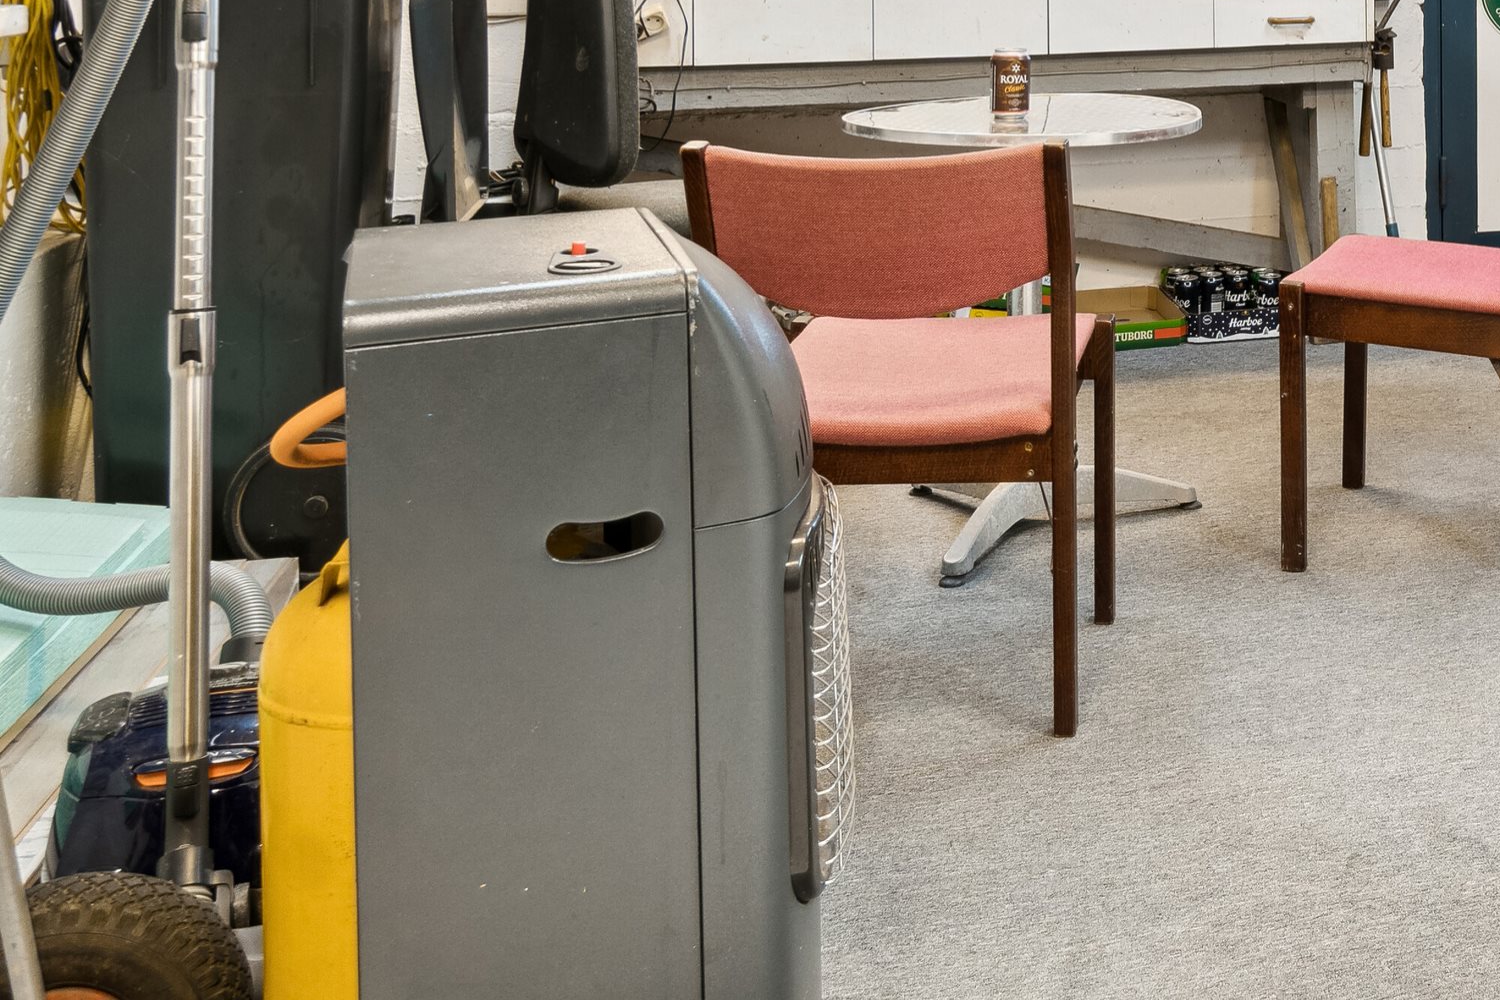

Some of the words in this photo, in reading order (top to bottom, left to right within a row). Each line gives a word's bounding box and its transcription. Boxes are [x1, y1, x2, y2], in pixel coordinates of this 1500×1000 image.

[1000, 74, 1028, 84] ROYAL
[1229, 317, 1263, 328] Harboe
[1115, 330, 1153, 342] TUBORG
